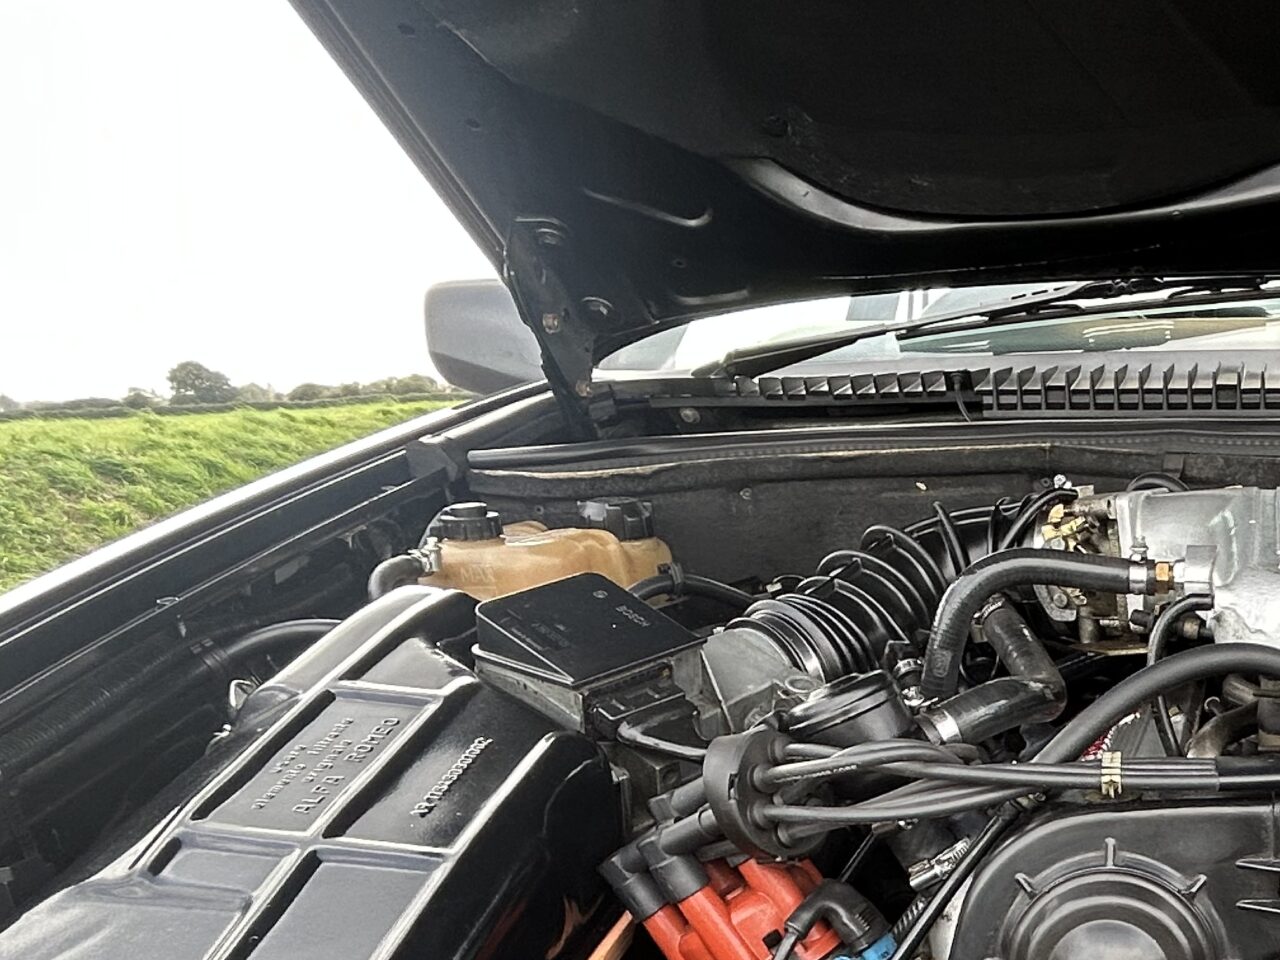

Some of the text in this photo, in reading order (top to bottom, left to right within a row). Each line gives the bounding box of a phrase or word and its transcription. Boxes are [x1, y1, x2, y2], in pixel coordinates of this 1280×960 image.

[615, 604, 650, 627] BOSCH
[292, 717, 400, 815] ALFA ROMEO
